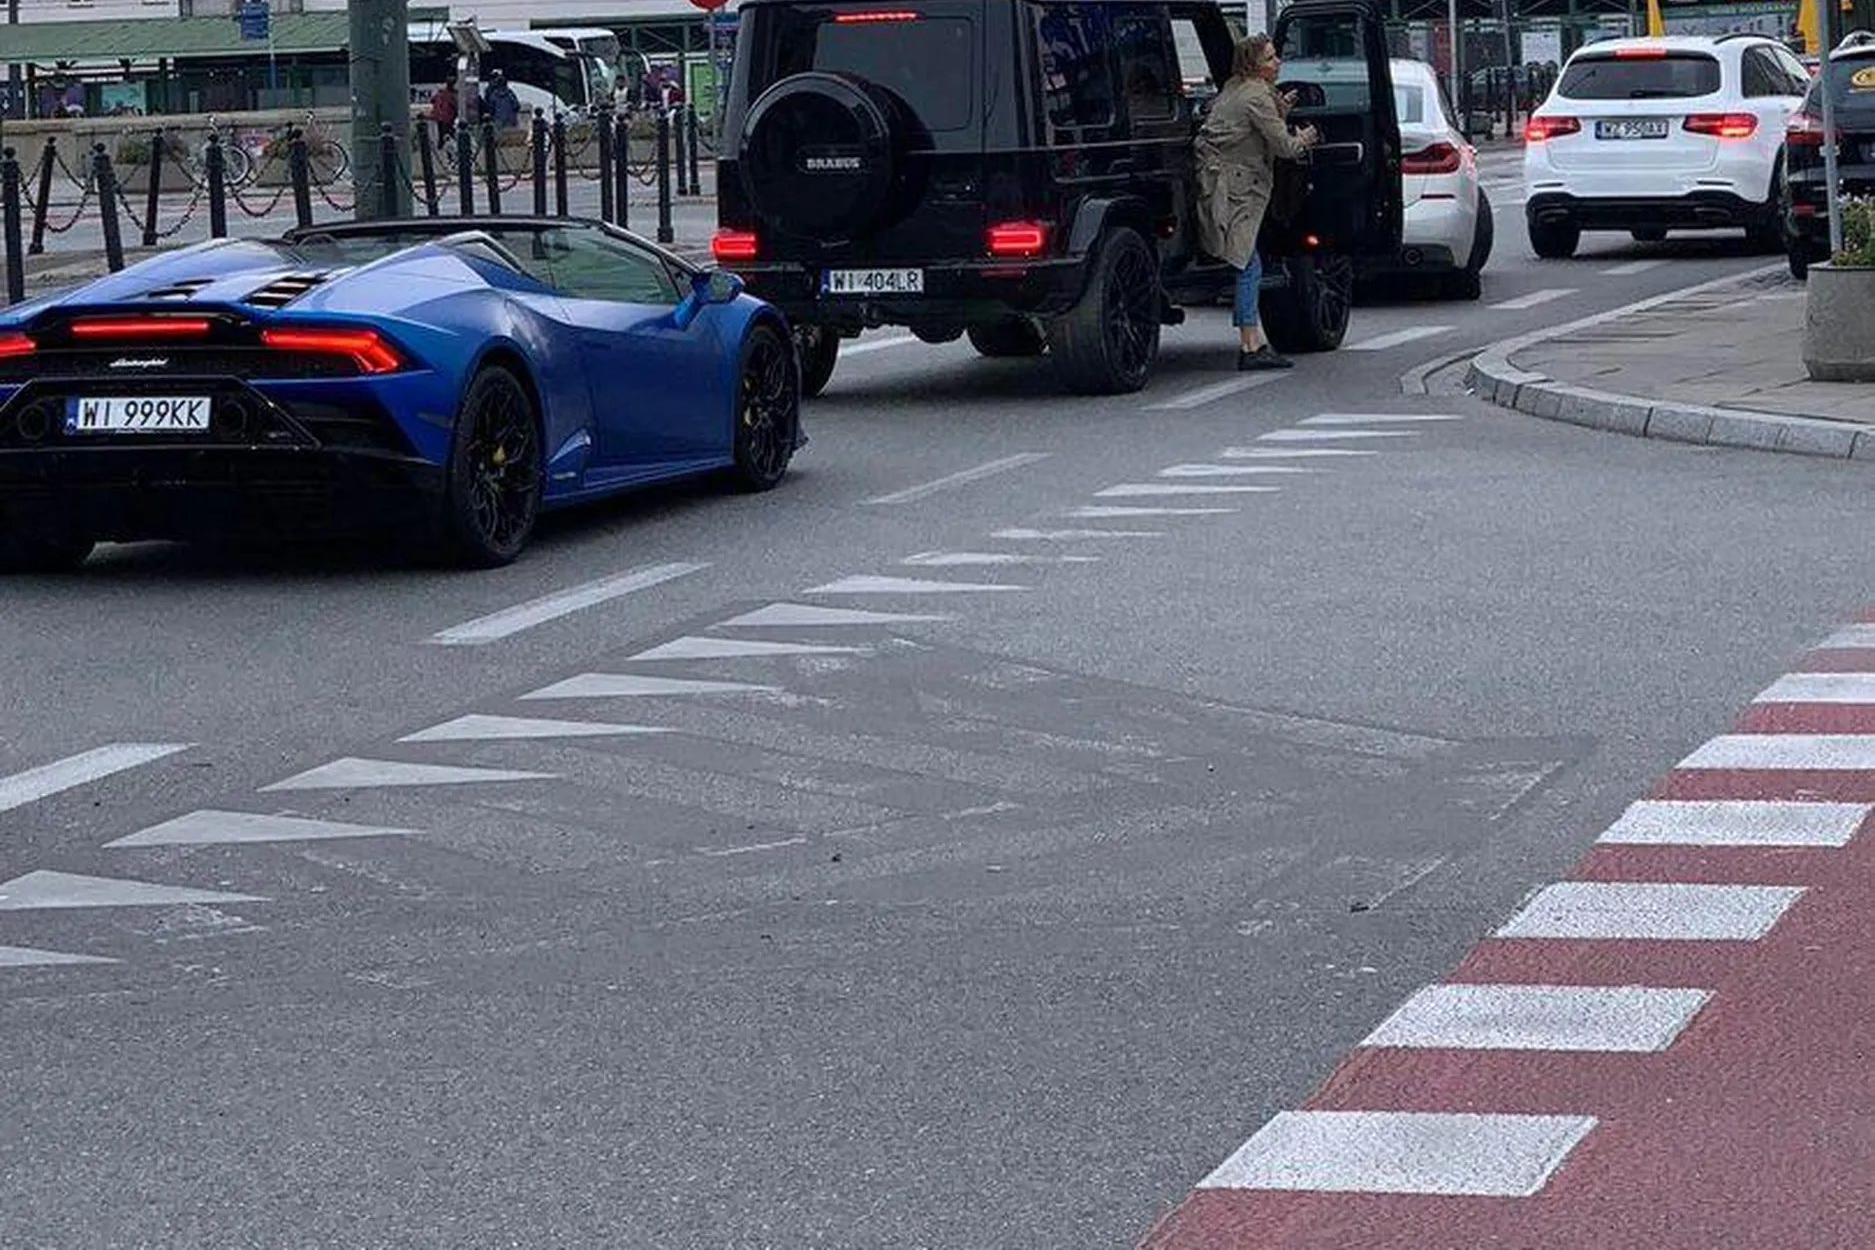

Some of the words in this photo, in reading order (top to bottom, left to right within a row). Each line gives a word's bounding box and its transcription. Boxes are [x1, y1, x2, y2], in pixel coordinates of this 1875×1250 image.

[806, 156, 861, 169] BRABUS
[833, 272, 853, 290] WI
[863, 271, 919, 290] 404LR
[83, 400, 111, 427] WI
[124, 400, 204, 427] 999KK
